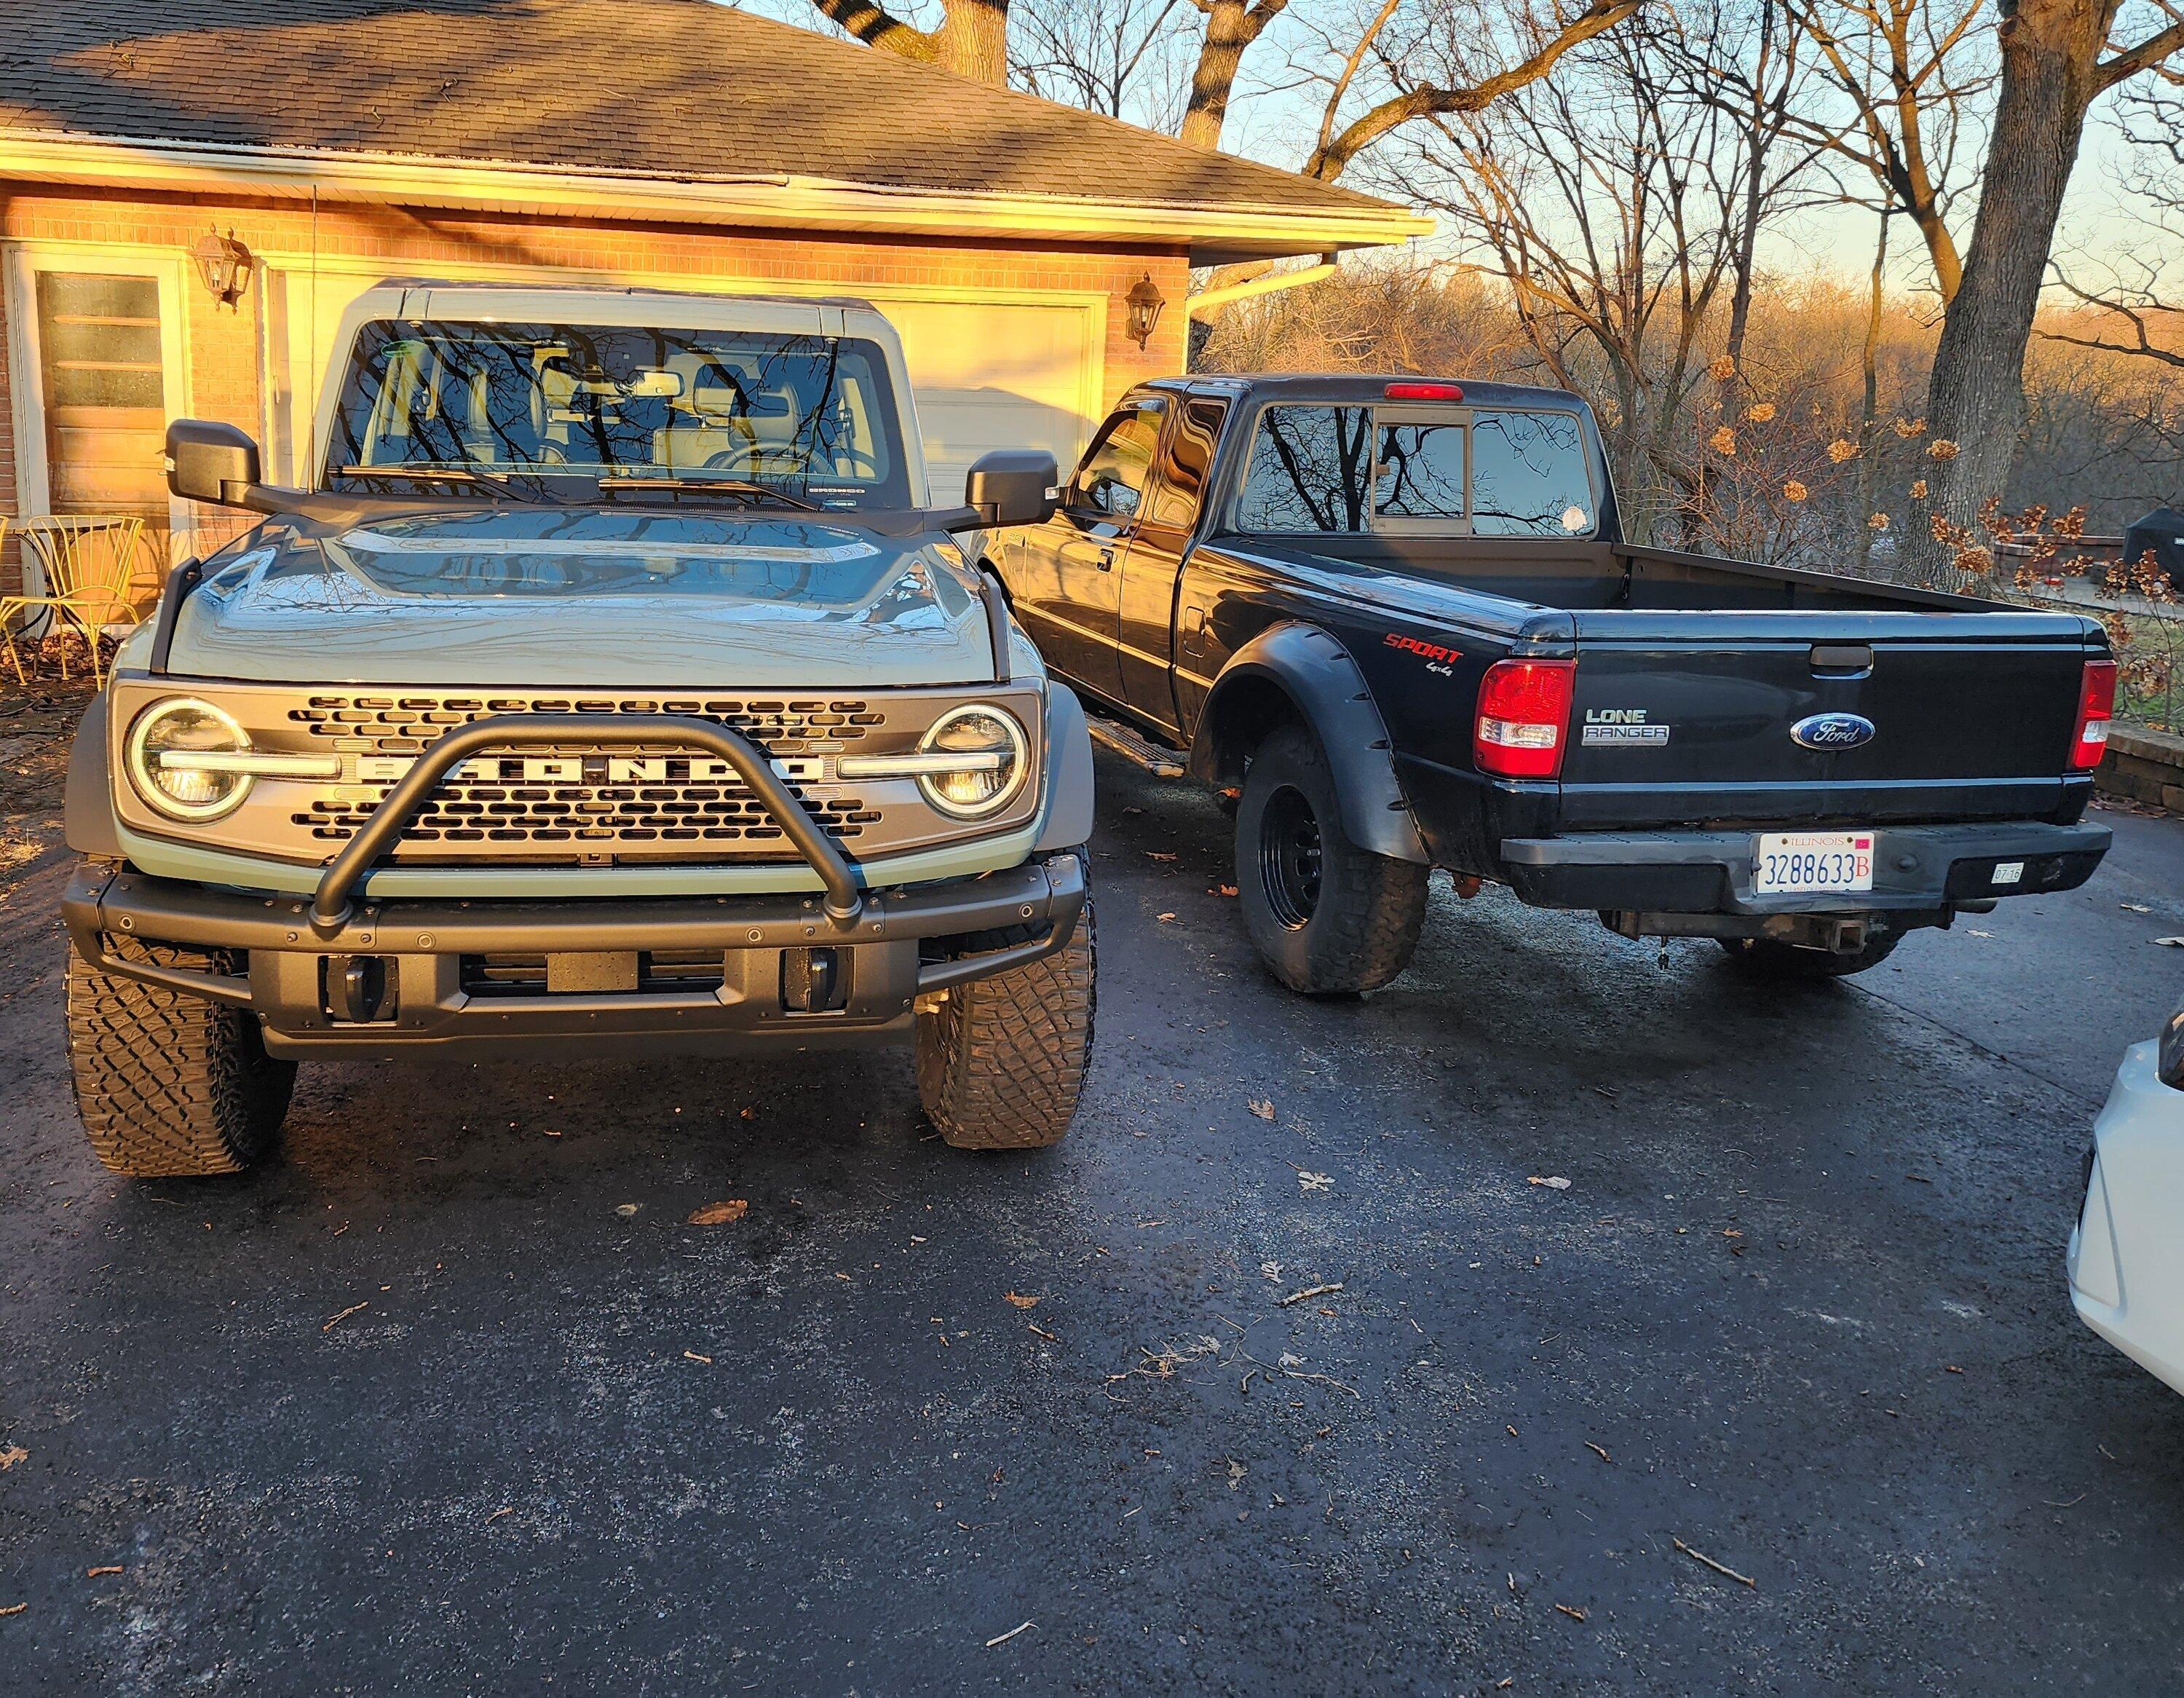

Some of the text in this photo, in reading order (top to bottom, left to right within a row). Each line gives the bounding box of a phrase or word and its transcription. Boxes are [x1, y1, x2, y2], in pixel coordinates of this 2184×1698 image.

[1383, 632, 1465, 664] SPORT
[1586, 708, 1647, 724] LONE
[1585, 727, 1668, 738] RANGER
[1813, 721, 1860, 742] Ford
[1791, 837, 1845, 847] ILLINOIS
[1995, 869, 2021, 879] 07 16
